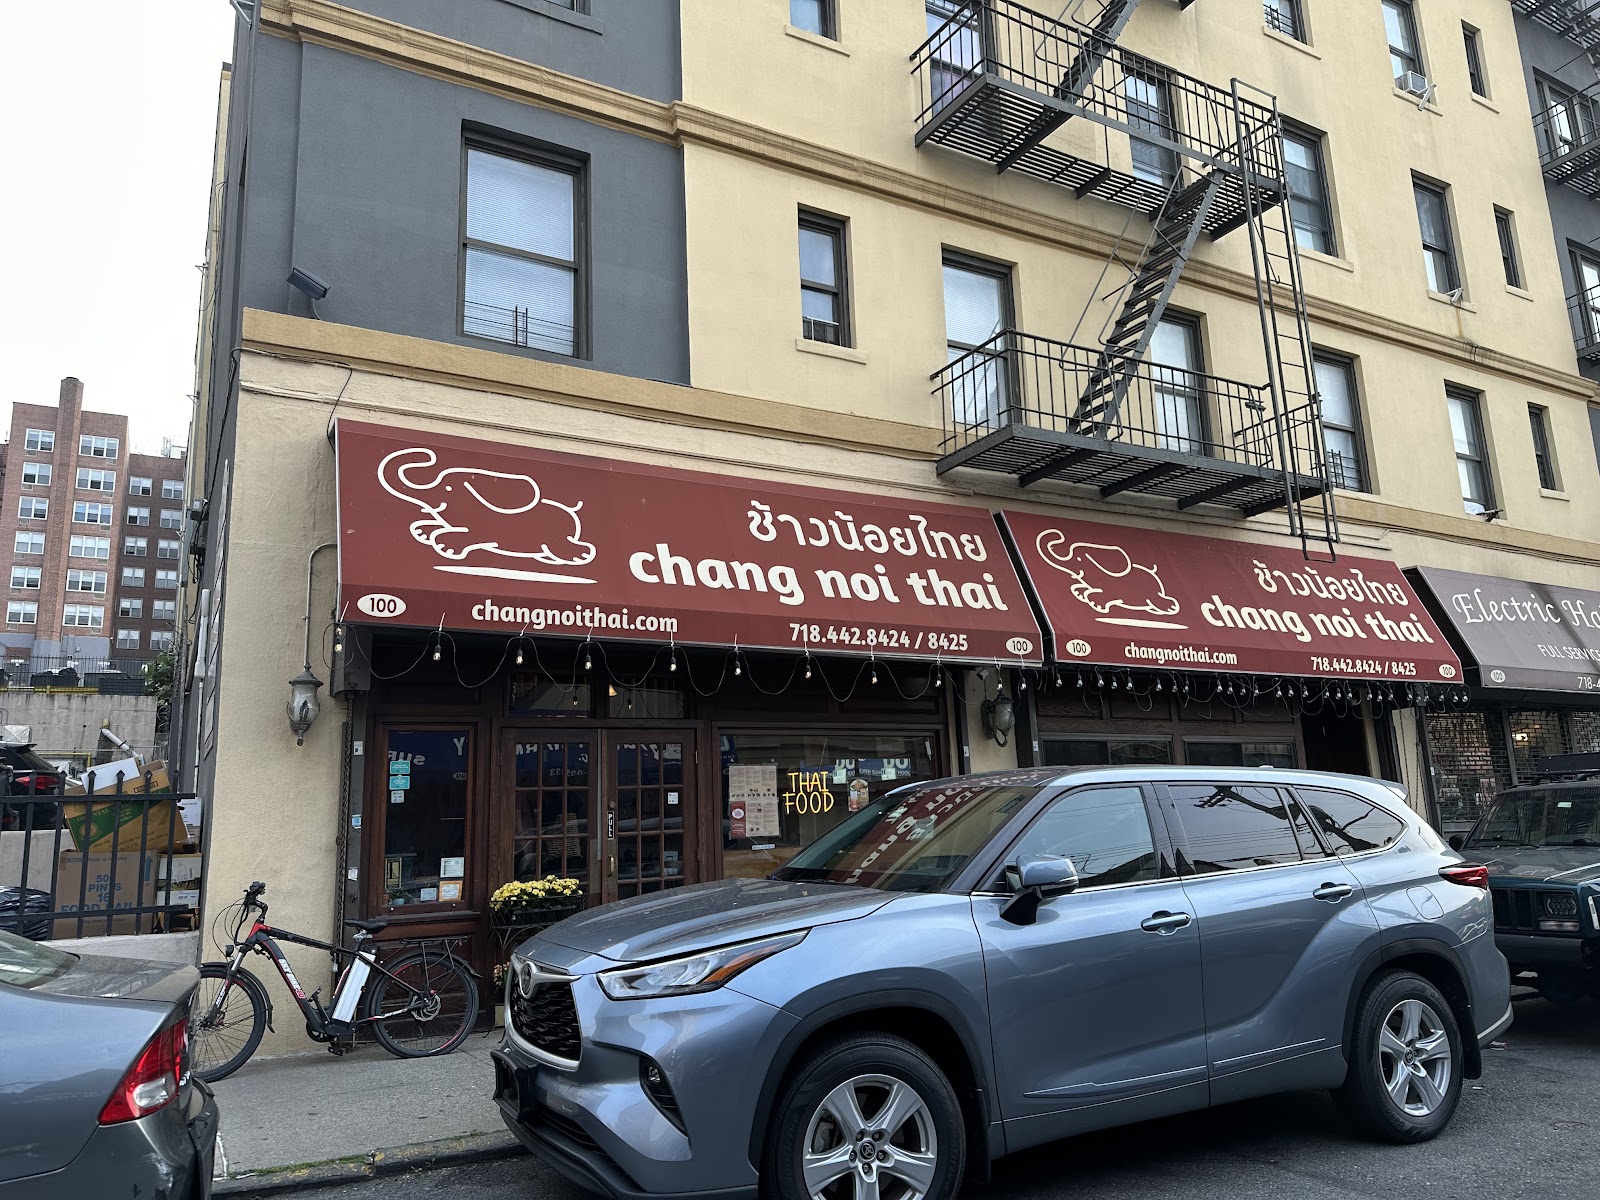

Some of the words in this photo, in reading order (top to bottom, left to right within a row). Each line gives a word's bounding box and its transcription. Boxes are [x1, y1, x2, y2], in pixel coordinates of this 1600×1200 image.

[629, 543, 805, 606] chang
[816, 564, 900, 603] noi
[905, 569, 1008, 611] thai
[369, 597, 397, 614] 100
[471, 599, 678, 633] changnoithai.com
[1452, 588, 1561, 623] Electric
[1200, 595, 1312, 643] chang
[1309, 607, 1368, 639] noi
[1364, 611, 1435, 644] thai
[789, 623, 911, 648] 718.442.8424
[928, 632, 968, 651] 8425
[1012, 639, 1029, 652] 100
[1071, 642, 1087, 654] 100
[1124, 642, 1238, 665] changnoithai.com
[1537, 644, 1565, 659] FULL
[1310, 656, 1382, 675] 718.442.8424
[1391, 662, 1417, 676] 8425
[788, 771, 829, 793] THAI
[782, 791, 835, 815] FOOD
[96, 874, 110, 883] 50
